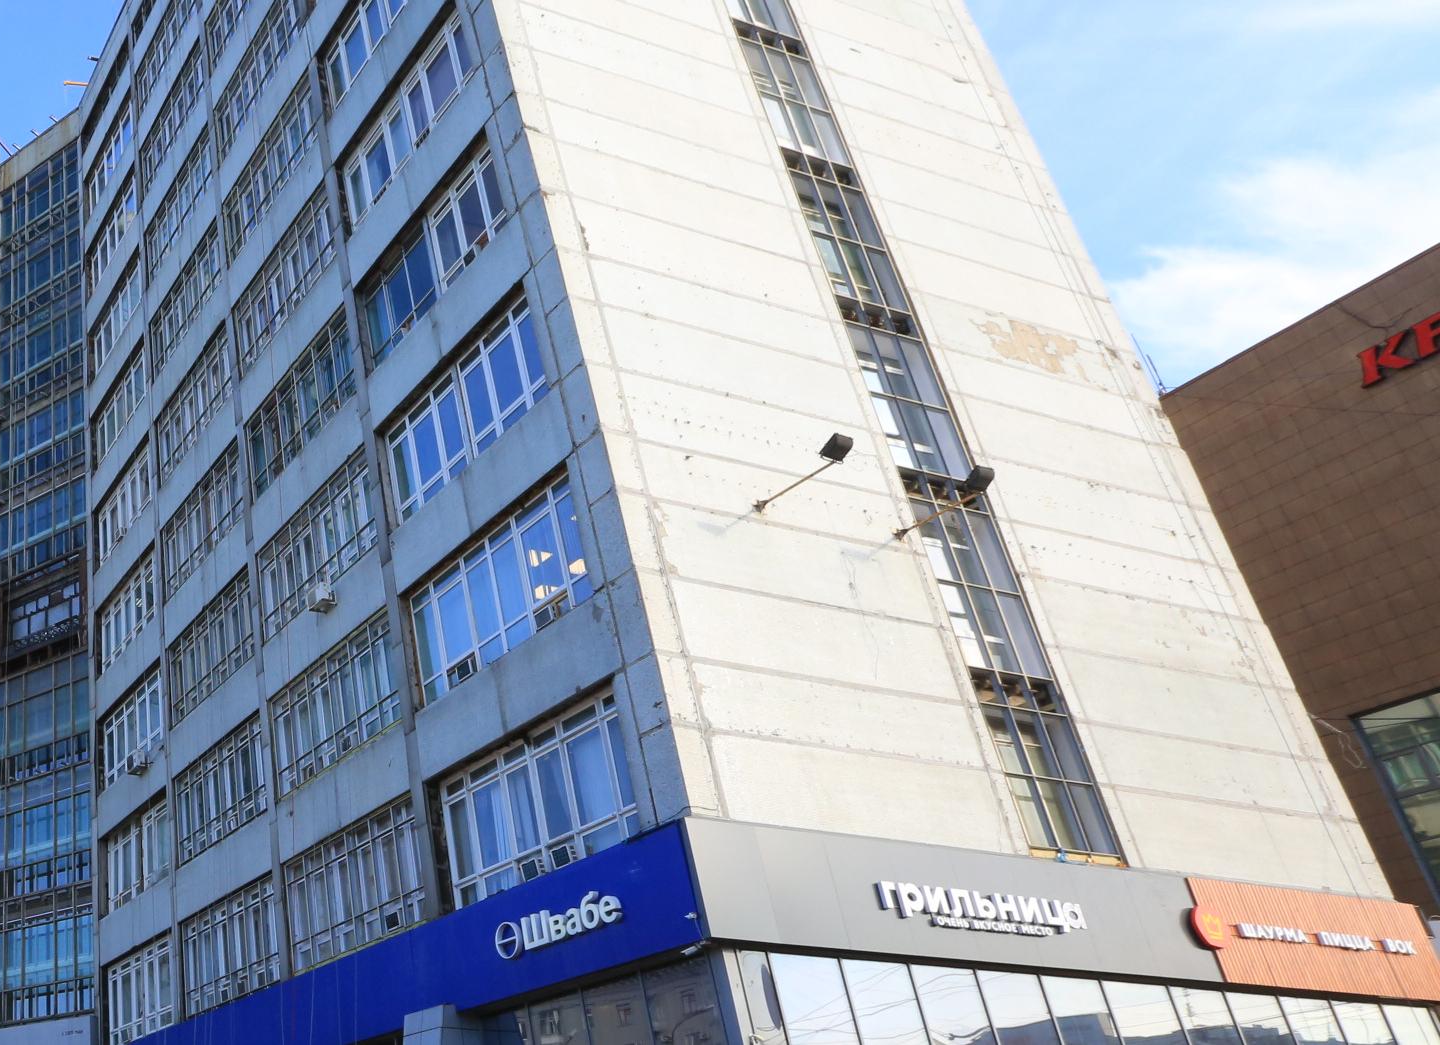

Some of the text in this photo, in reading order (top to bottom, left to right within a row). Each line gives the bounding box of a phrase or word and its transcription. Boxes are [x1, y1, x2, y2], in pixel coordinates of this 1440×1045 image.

[521, 891, 623, 950] Швабе
[935, 916, 1054, 936] ОЧЕНЬ ВКУСНОЕ МЕСТО
[1237, 922, 1417, 955] ШАУРМА ПИЦЦА ВОК
